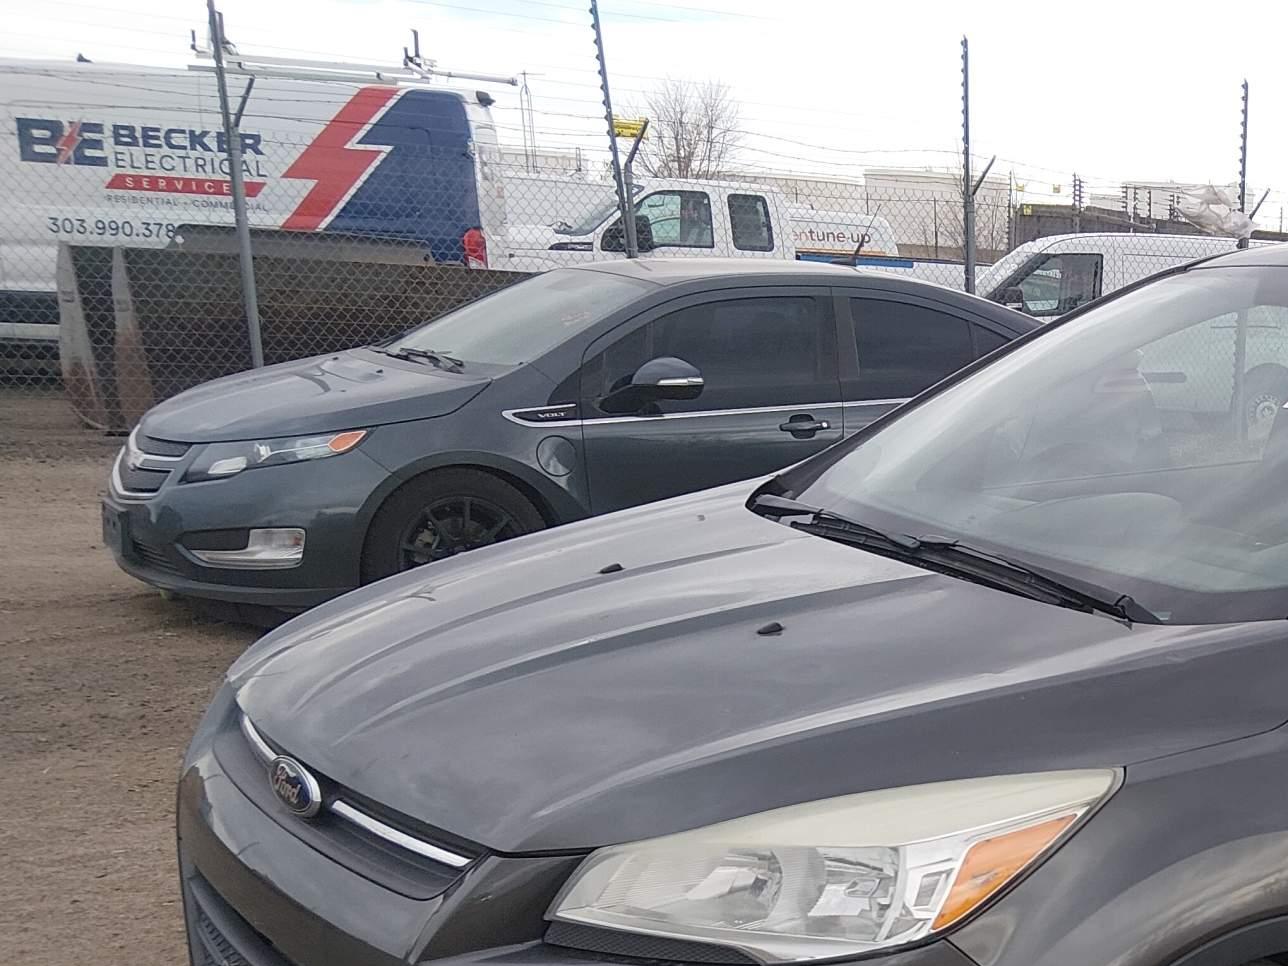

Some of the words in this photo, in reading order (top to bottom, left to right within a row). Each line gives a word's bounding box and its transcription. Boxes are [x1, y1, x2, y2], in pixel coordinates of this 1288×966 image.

[112, 124, 266, 155] BECKER
[115, 152, 268, 177] ELECTRICAL
[105, 194, 179, 207] RESIDENTIAL
[192, 200, 269, 212] COMMECIAL
